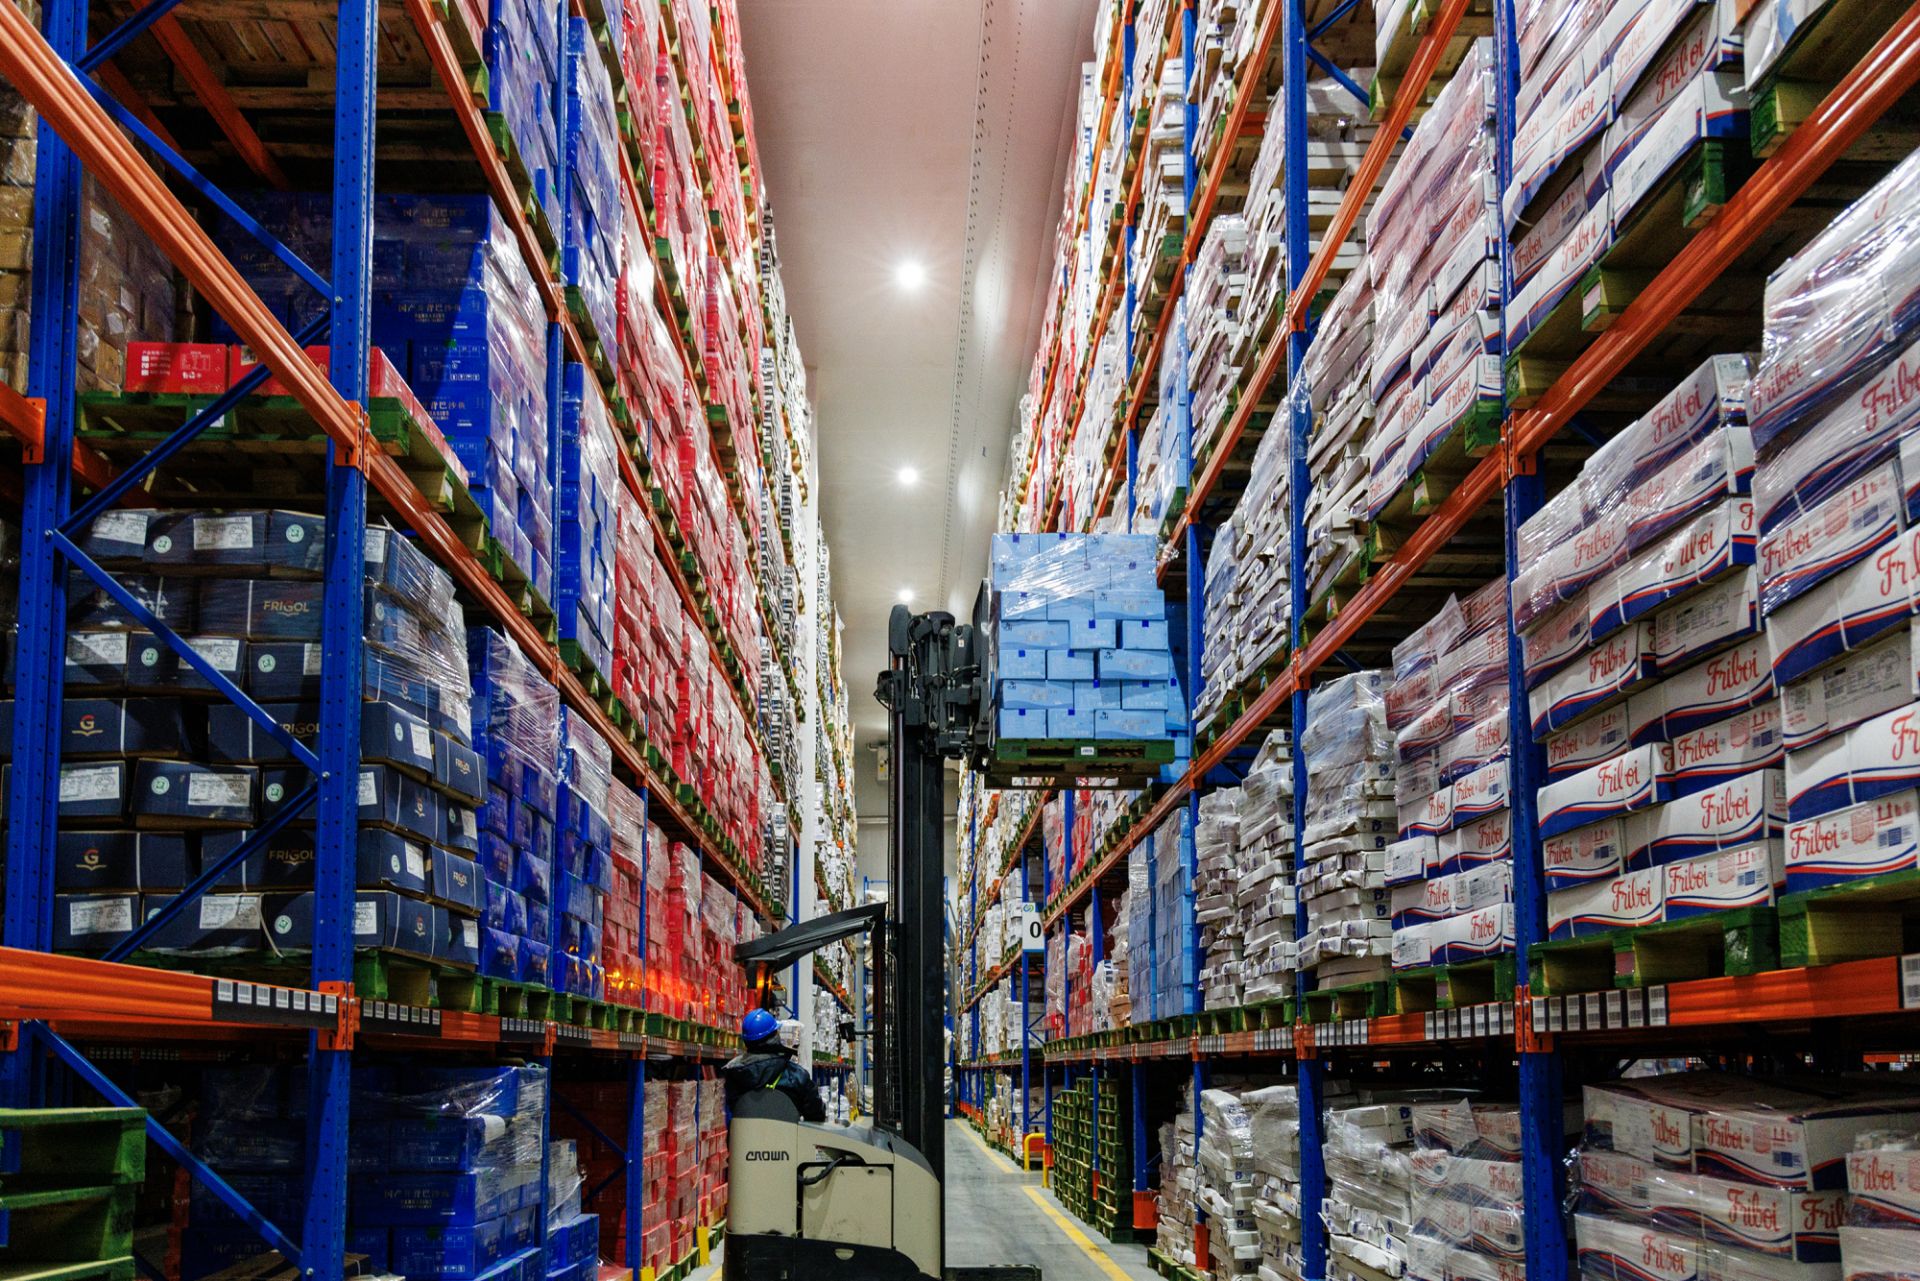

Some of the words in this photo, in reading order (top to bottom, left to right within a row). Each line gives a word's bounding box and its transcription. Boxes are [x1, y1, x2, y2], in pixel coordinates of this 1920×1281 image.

[1514, 231, 1543, 274] Friboi
[1761, 524, 1812, 576] Friboi
[263, 599, 309, 612] FRIGOL
[1707, 649, 1759, 696] Friboi
[280, 722, 320, 734] RIGOL
[1549, 733, 1579, 764] Friboi
[1678, 732, 1721, 767] Friboi
[1701, 787, 1751, 829] Friboi
[1478, 822, 1504, 849] Friboi
[1790, 820, 1839, 860] Friboi
[1545, 840, 1573, 866] Friboi
[1611, 876, 1652, 912] Friboi
[1669, 862, 1709, 894] Friboi
[1471, 912, 1496, 940] Friboi
[1706, 1119, 1745, 1150] Friboi
[746, 1151, 789, 1161] CROWN
[1851, 1156, 1896, 1191] Friboi
[1726, 1188, 1781, 1232] Friboi
